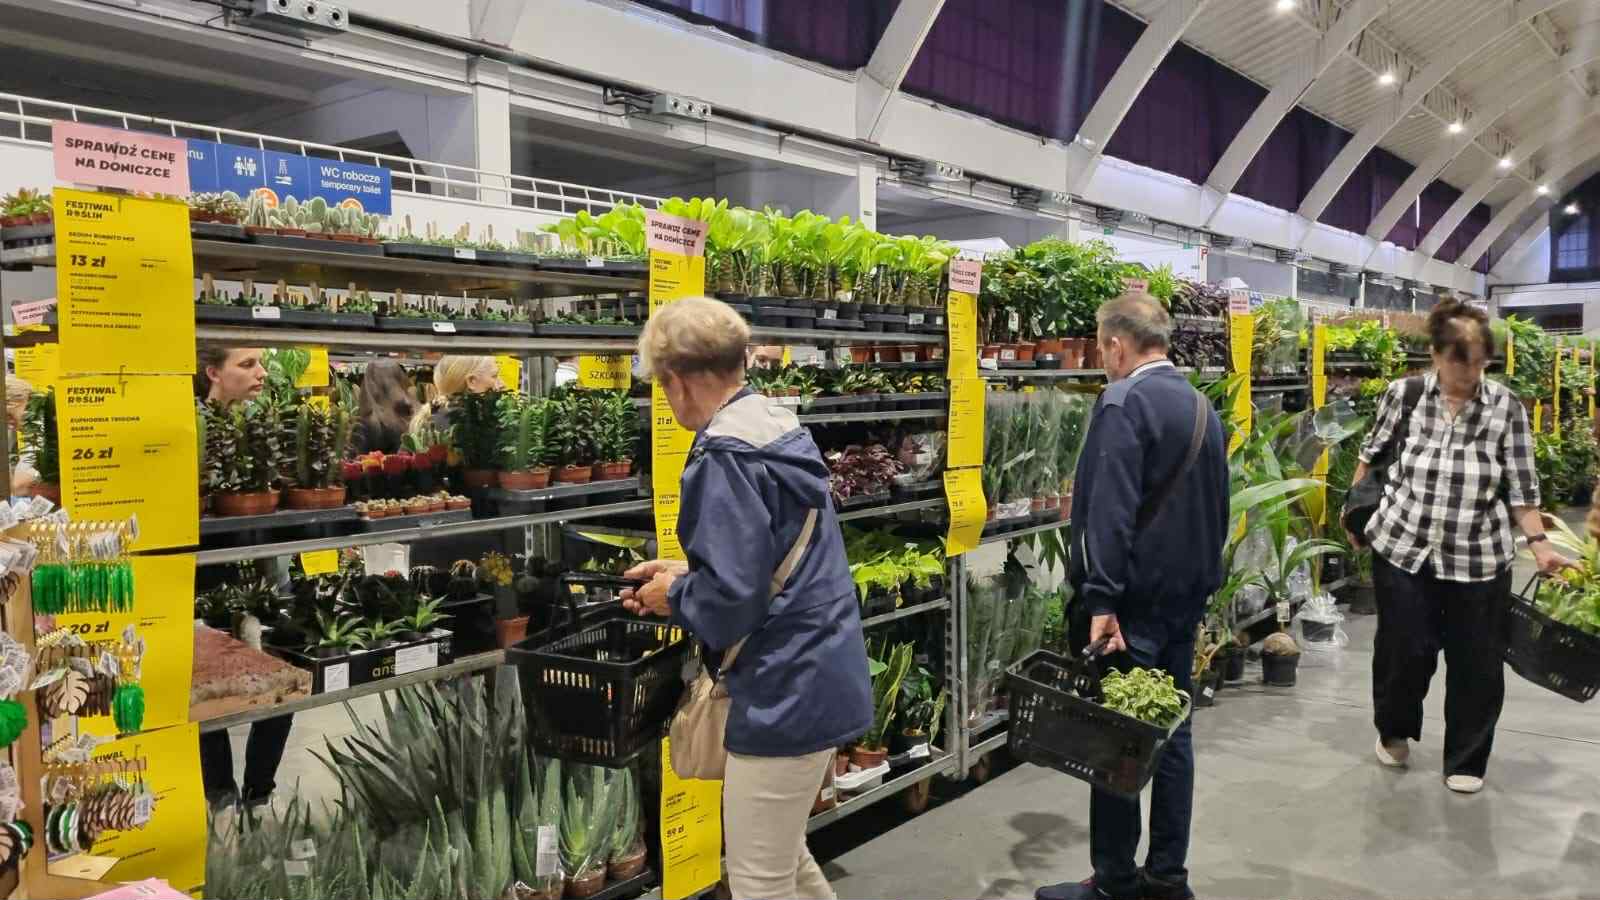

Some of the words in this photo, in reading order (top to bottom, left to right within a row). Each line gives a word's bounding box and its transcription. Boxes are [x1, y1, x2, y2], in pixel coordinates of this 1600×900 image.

[65, 137, 137, 157] SPRAWDŹ
[141, 148, 175, 164] CENĘ
[75, 157, 95, 168] NA
[99, 160, 170, 178] DONICZCE
[320, 166, 339, 178] WC
[342, 170, 380, 184] robocze
[65, 200, 113, 212] FESTIWAL
[71, 254, 87, 266] 13
[91, 255, 106, 267] zł
[67, 387, 116, 395] FESTIWAL
[72, 448, 94, 460] 26
[98, 446, 113, 459] zł
[662, 528, 672, 536] 22
[70, 623, 91, 634] 20
[95, 620, 110, 633] zł
